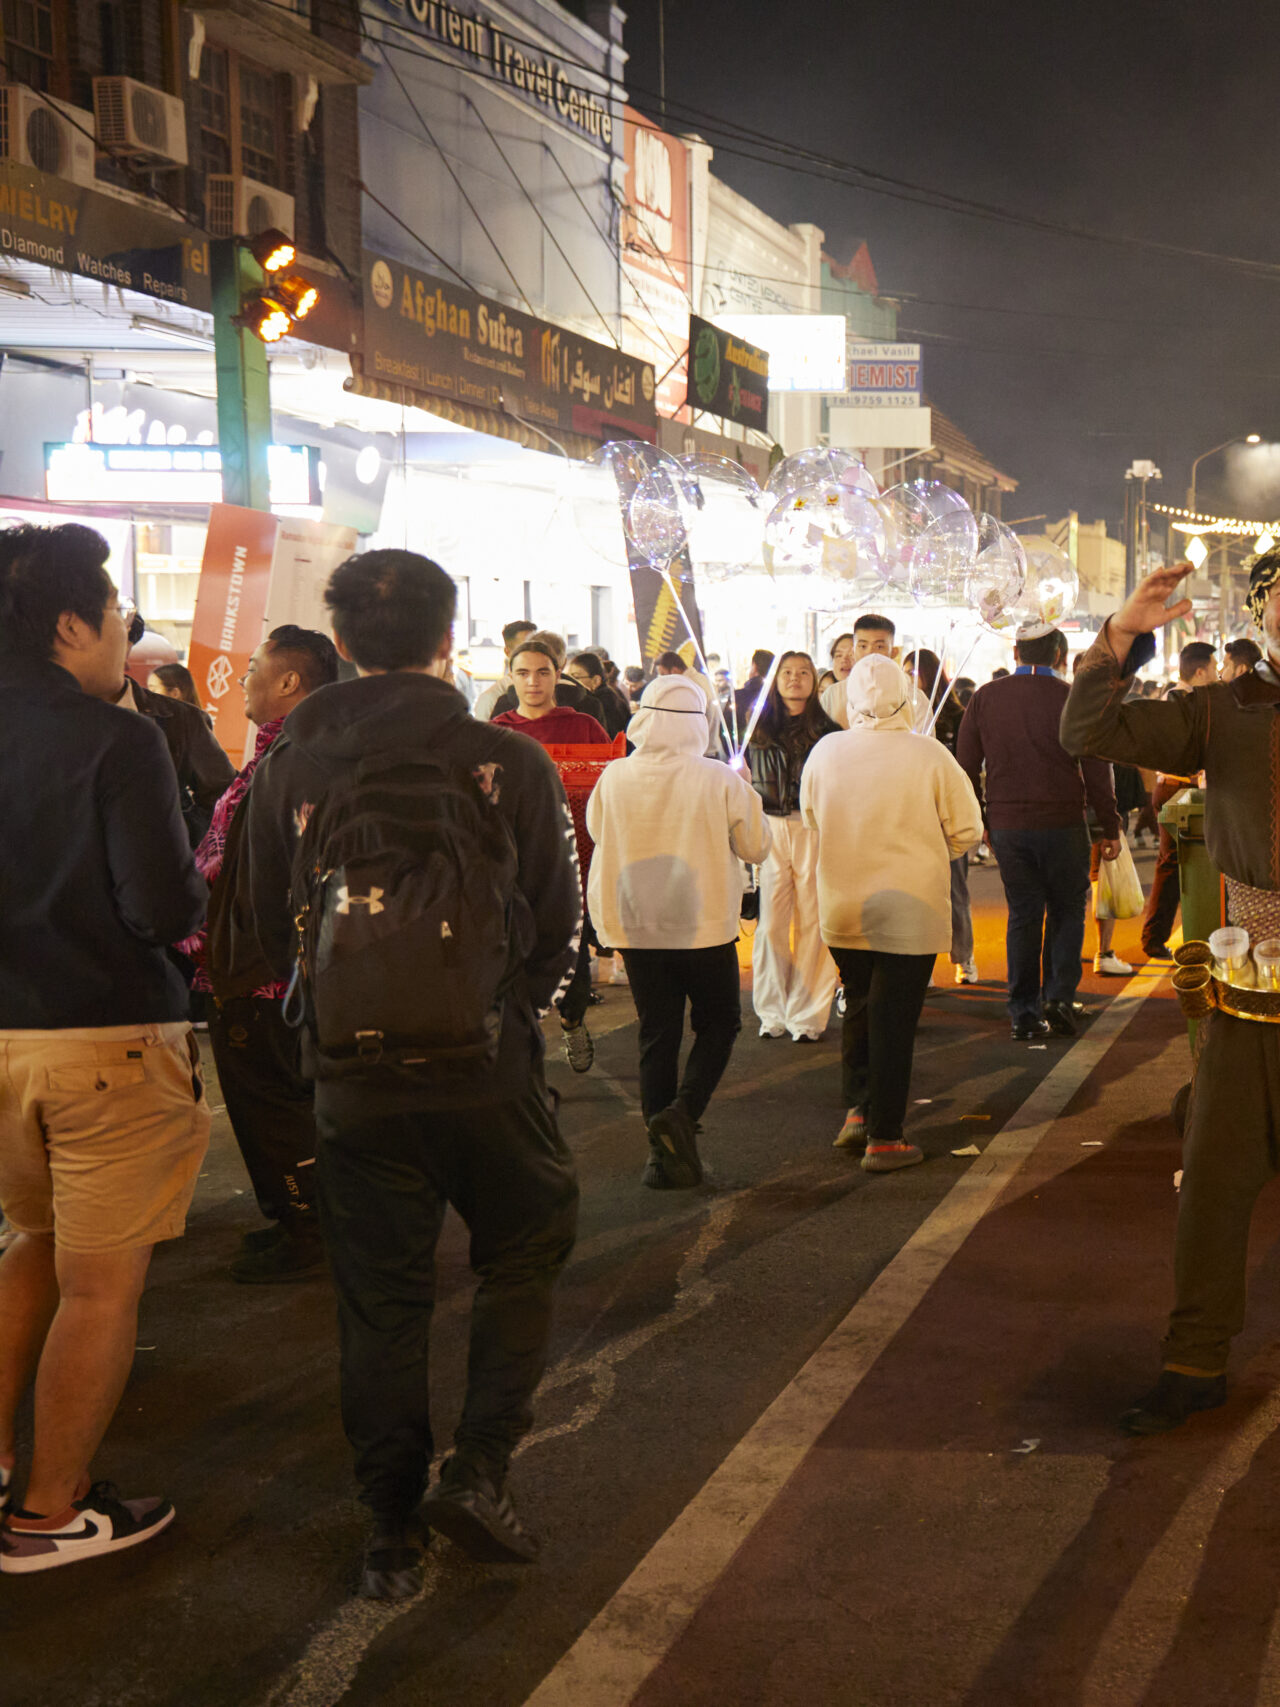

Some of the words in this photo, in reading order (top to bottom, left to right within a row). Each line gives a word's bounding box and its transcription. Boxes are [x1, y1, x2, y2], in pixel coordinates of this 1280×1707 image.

[409, 0, 484, 62] Orient
[491, 21, 553, 109] Travel
[556, 69, 612, 145] Centre
[1, 228, 64, 265] Diamond
[77, 252, 132, 286] Watches
[143, 272, 189, 302] Repairs
[180, 237, 209, 275] Tel
[401, 274, 471, 338] Afghan
[477, 303, 524, 358] Sufra
[375, 351, 420, 380] Breakfast
[426, 366, 453, 390] Lunch
[459, 375, 486, 399] Dinner
[852, 346, 877, 356] hael
[882, 346, 914, 356] Vasili
[850, 364, 918, 387] EMIST
[854, 395, 882, 405] 9759
[887, 396, 914, 405] 1125
[219, 545, 248, 652] BANKSTOWN
